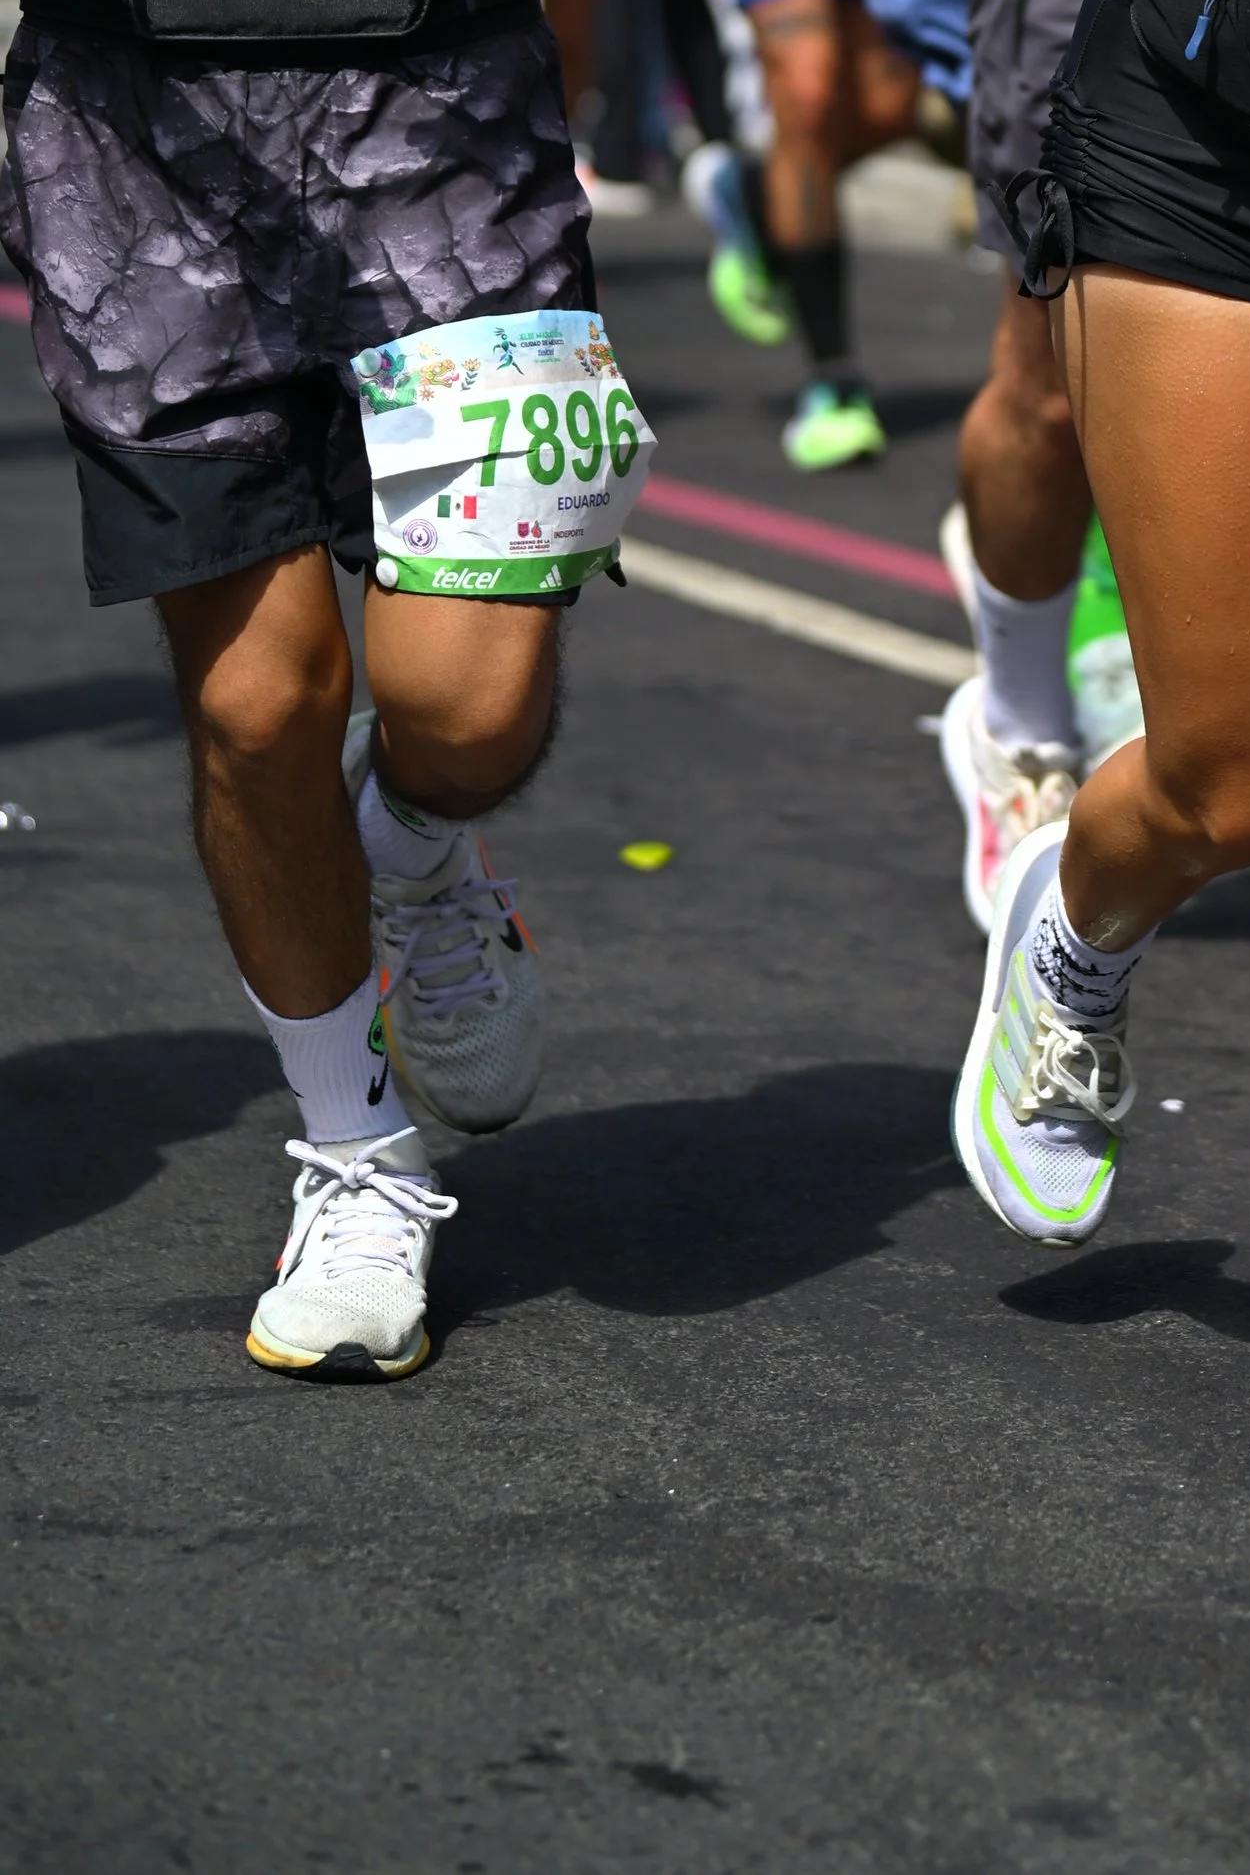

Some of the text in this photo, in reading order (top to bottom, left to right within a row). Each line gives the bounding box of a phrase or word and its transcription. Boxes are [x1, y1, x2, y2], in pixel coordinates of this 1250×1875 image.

[459, 387, 640, 488] 7896
[557, 492, 611, 511] EDUARDO
[553, 528, 585, 539] INDEPORTE
[432, 566, 503, 590] telcel
